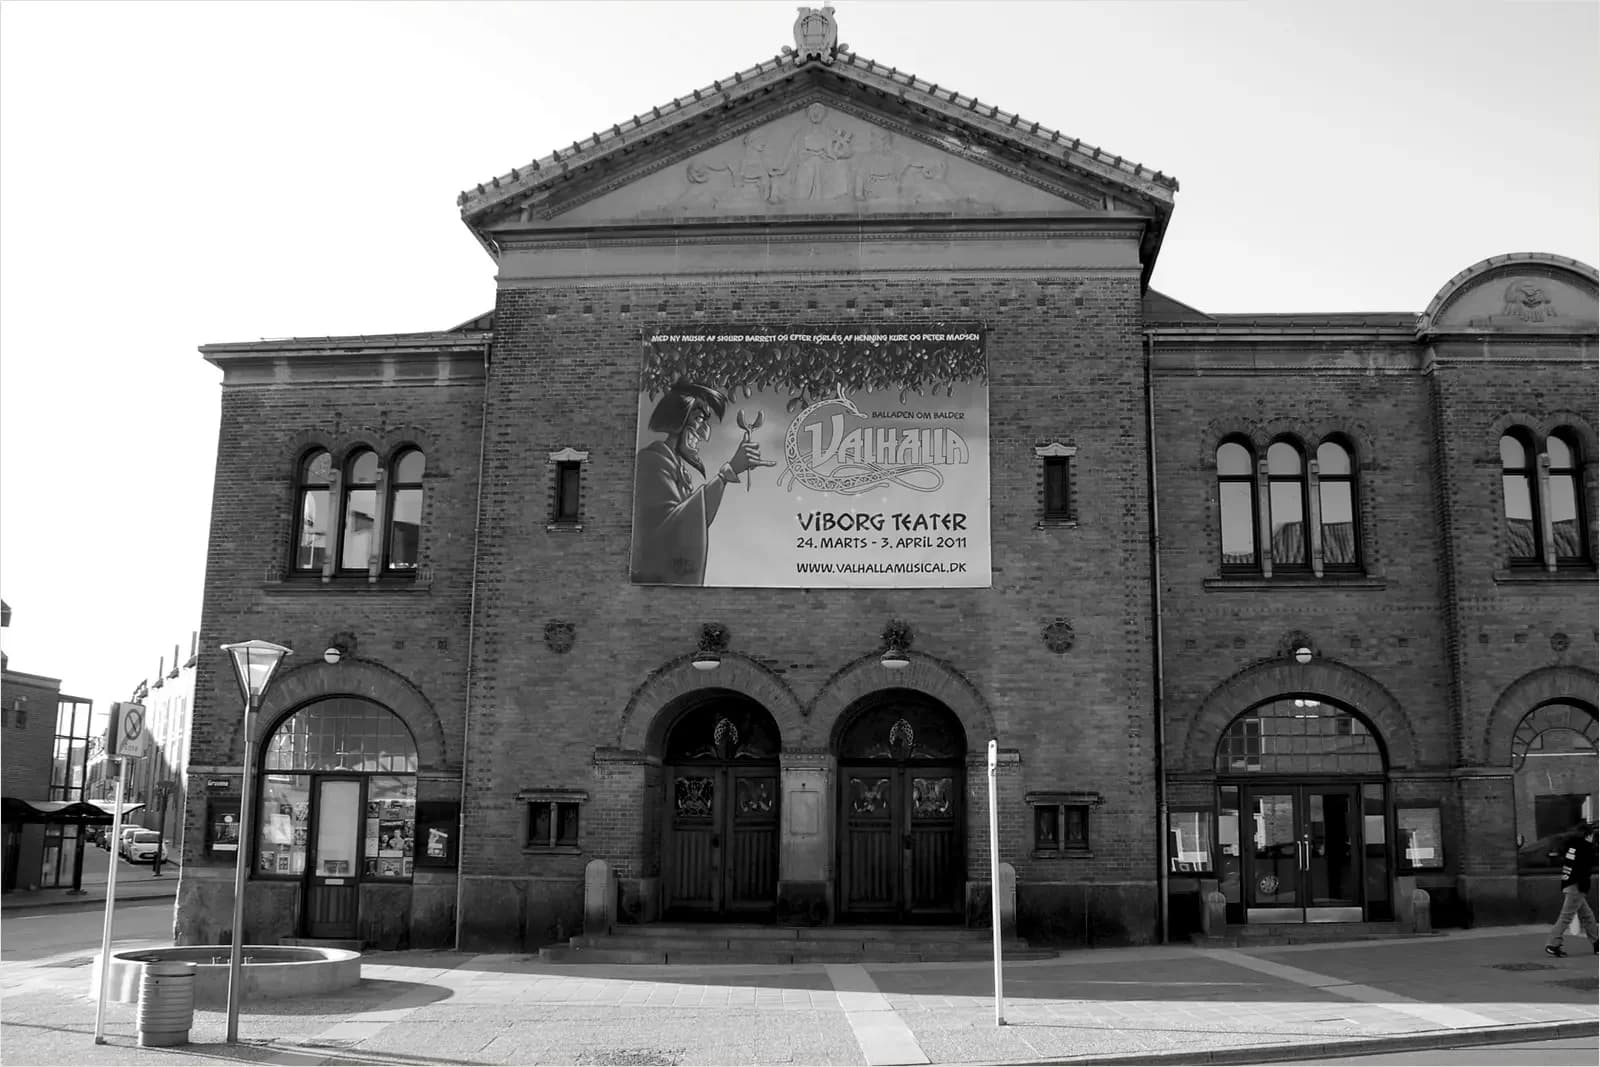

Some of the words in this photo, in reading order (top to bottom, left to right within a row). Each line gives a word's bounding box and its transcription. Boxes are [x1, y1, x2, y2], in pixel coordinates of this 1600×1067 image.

[854, 334, 887, 342] HENNING
[889, 334, 908, 342] KURE
[922, 333, 945, 341] PETER
[946, 333, 980, 341] MADSEN
[872, 411, 914, 419] BALLADEN
[916, 411, 932, 419] OM
[934, 411, 965, 419] BALDER
[891, 513, 967, 531] TEATER
[796, 537, 818, 549] 24.
[820, 537, 867, 548] MARTS
[880, 537, 893, 549] 3.
[936, 536, 967, 548] 2011
[796, 562, 967, 574] WWW.VALHALLAMUSICAL.DK
